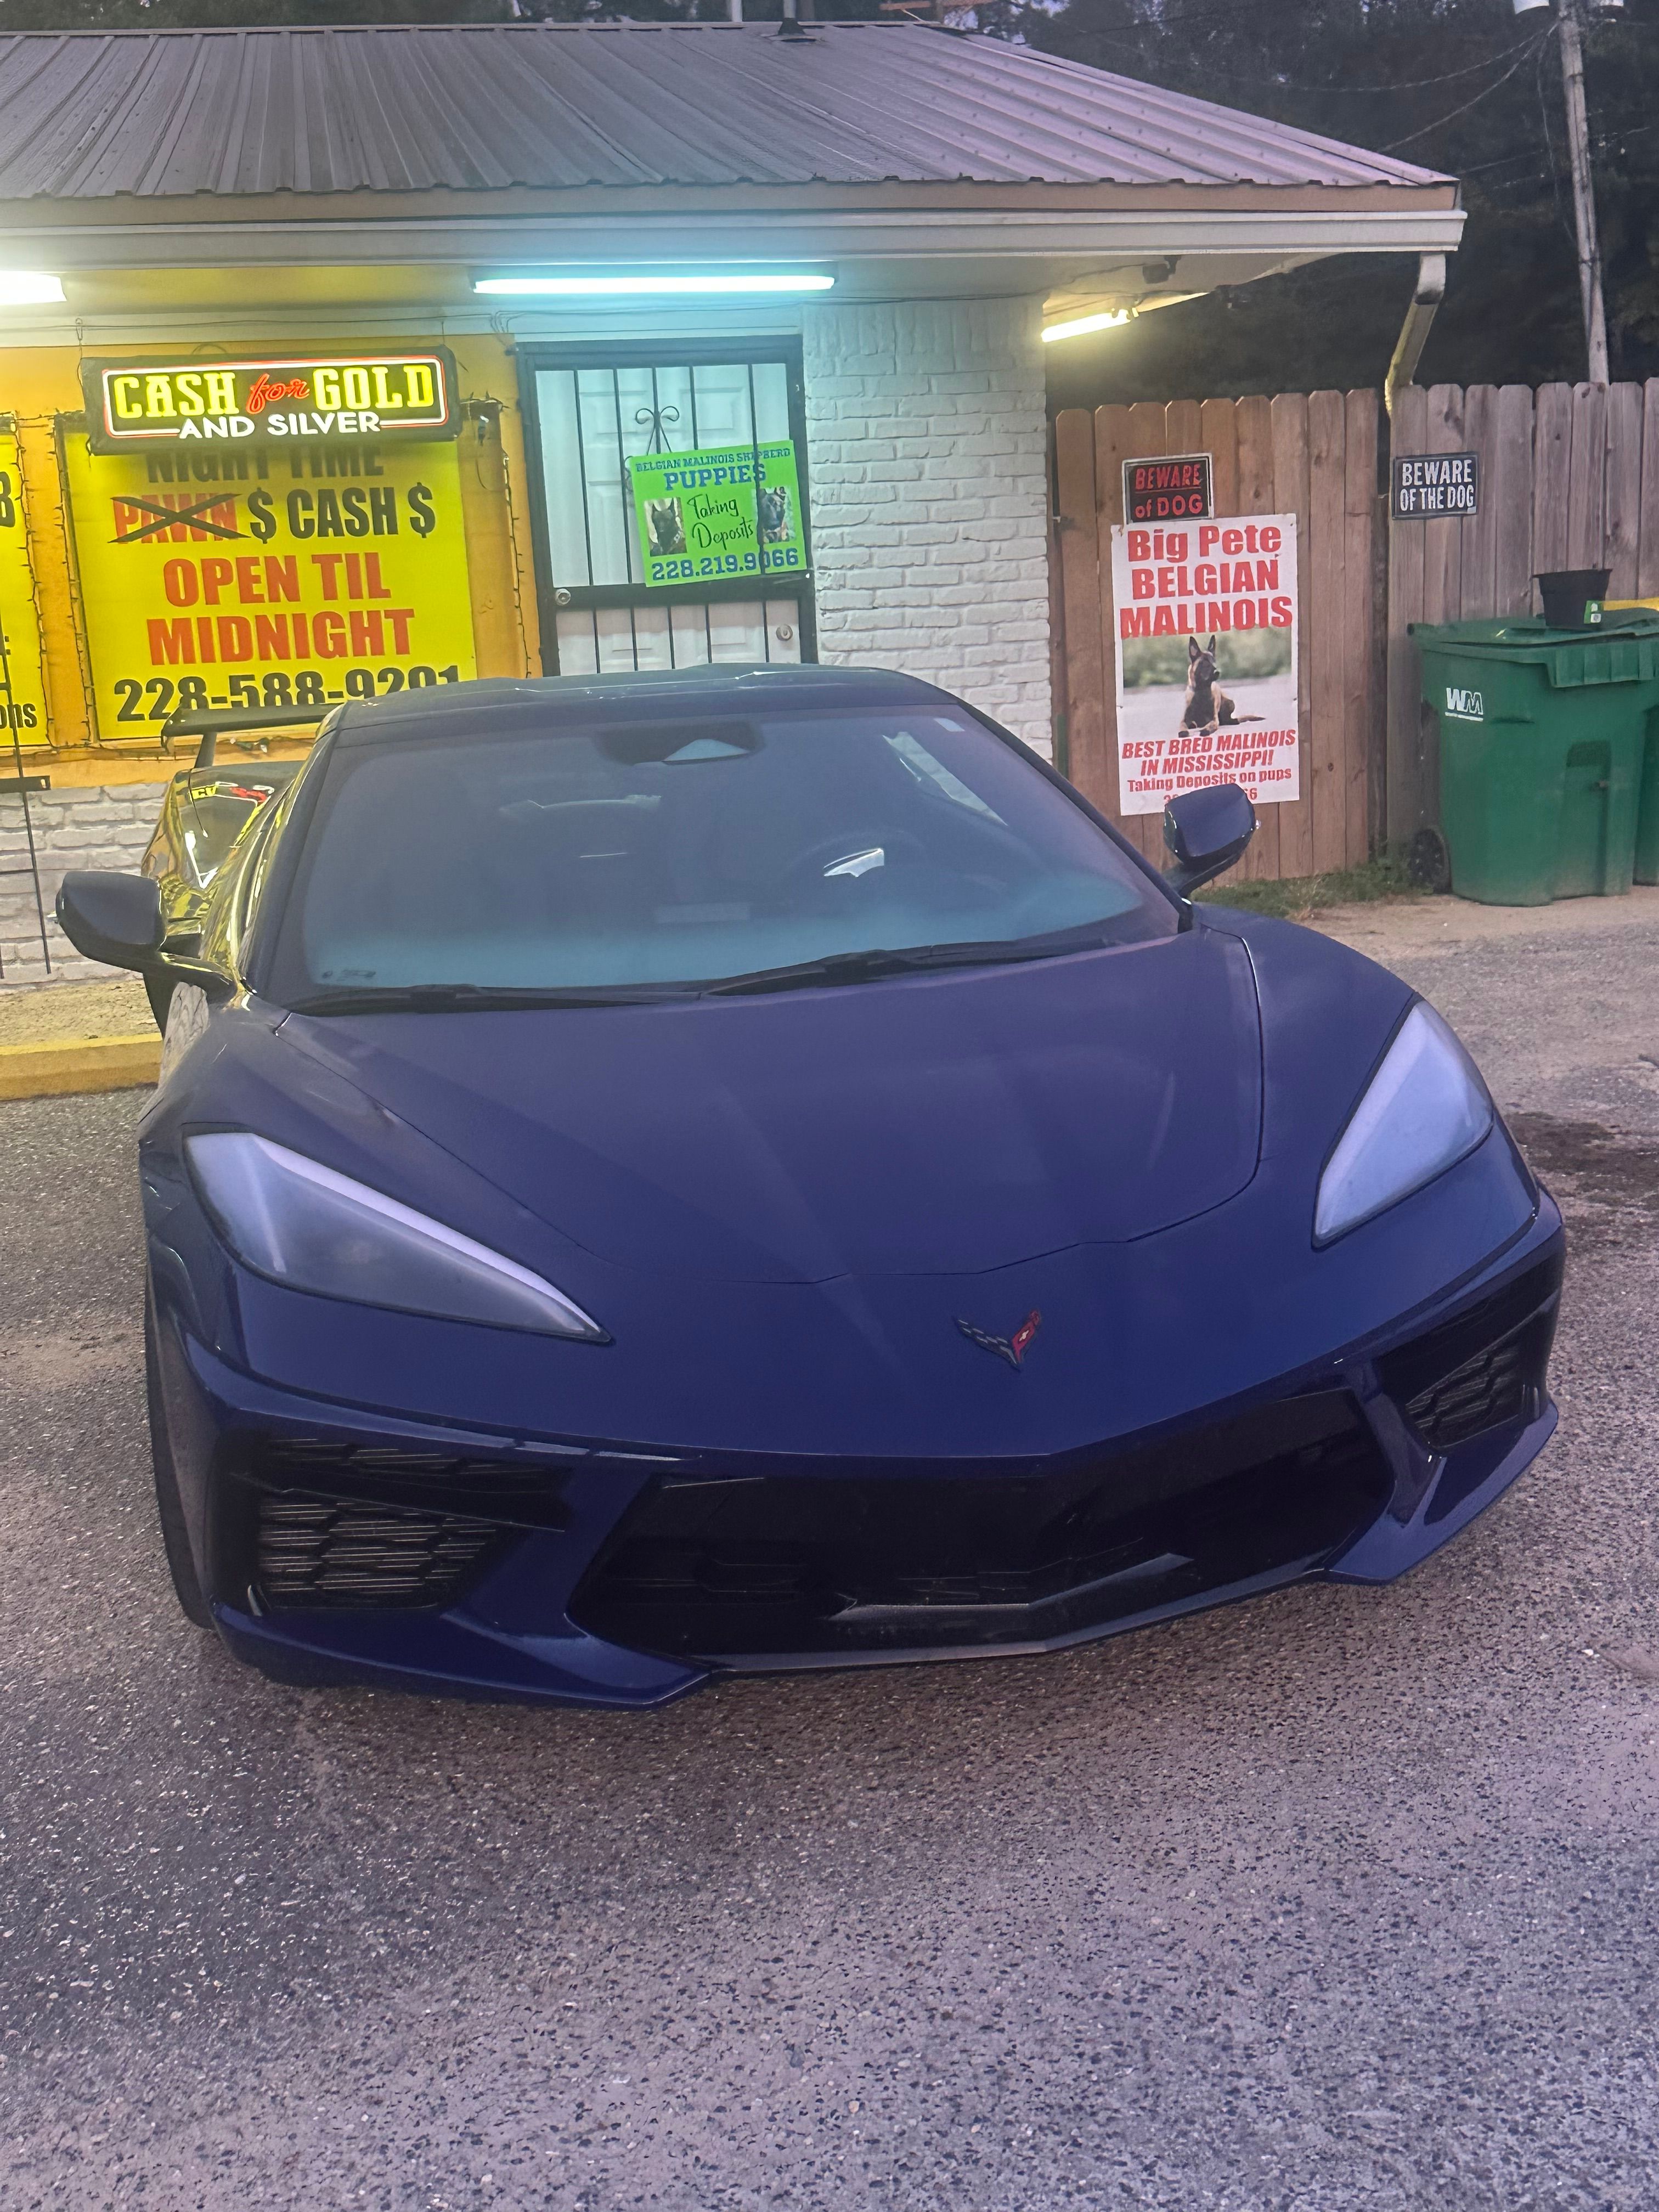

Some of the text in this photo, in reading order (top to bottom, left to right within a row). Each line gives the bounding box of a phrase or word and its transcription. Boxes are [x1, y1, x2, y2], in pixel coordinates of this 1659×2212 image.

[114, 364, 435, 419] CASH for GOLD
[179, 411, 381, 439] AND SILVER
[682, 454, 735, 467] MALINOIS
[1402, 460, 1472, 486] BEWARE
[663, 464, 766, 491] PUPPIES
[1136, 464, 1201, 490] BEWARE
[687, 494, 739, 520] Taking
[1135, 494, 1203, 518] of DOG
[1400, 484, 1474, 511] OF THE DOG
[113, 482, 436, 544] PAWN $ CASH $
[692, 516, 753, 551] Deposits
[1128, 525, 1281, 563] Big Pete
[652, 548, 798, 580] 228.219.9066
[163, 552, 392, 607] OPEN TIL
[1132, 560, 1279, 600] BELGIAN
[1120, 596, 1293, 640] MALINOIS
[147, 608, 415, 665] MIDNIGHT
[1446, 687, 1483, 715] WM
[1122, 729, 1296, 759] BEST BRED MALINOIS
[1127, 769, 1292, 792] Taking Deposits on pups
[1141, 759, 1159, 776] IN
